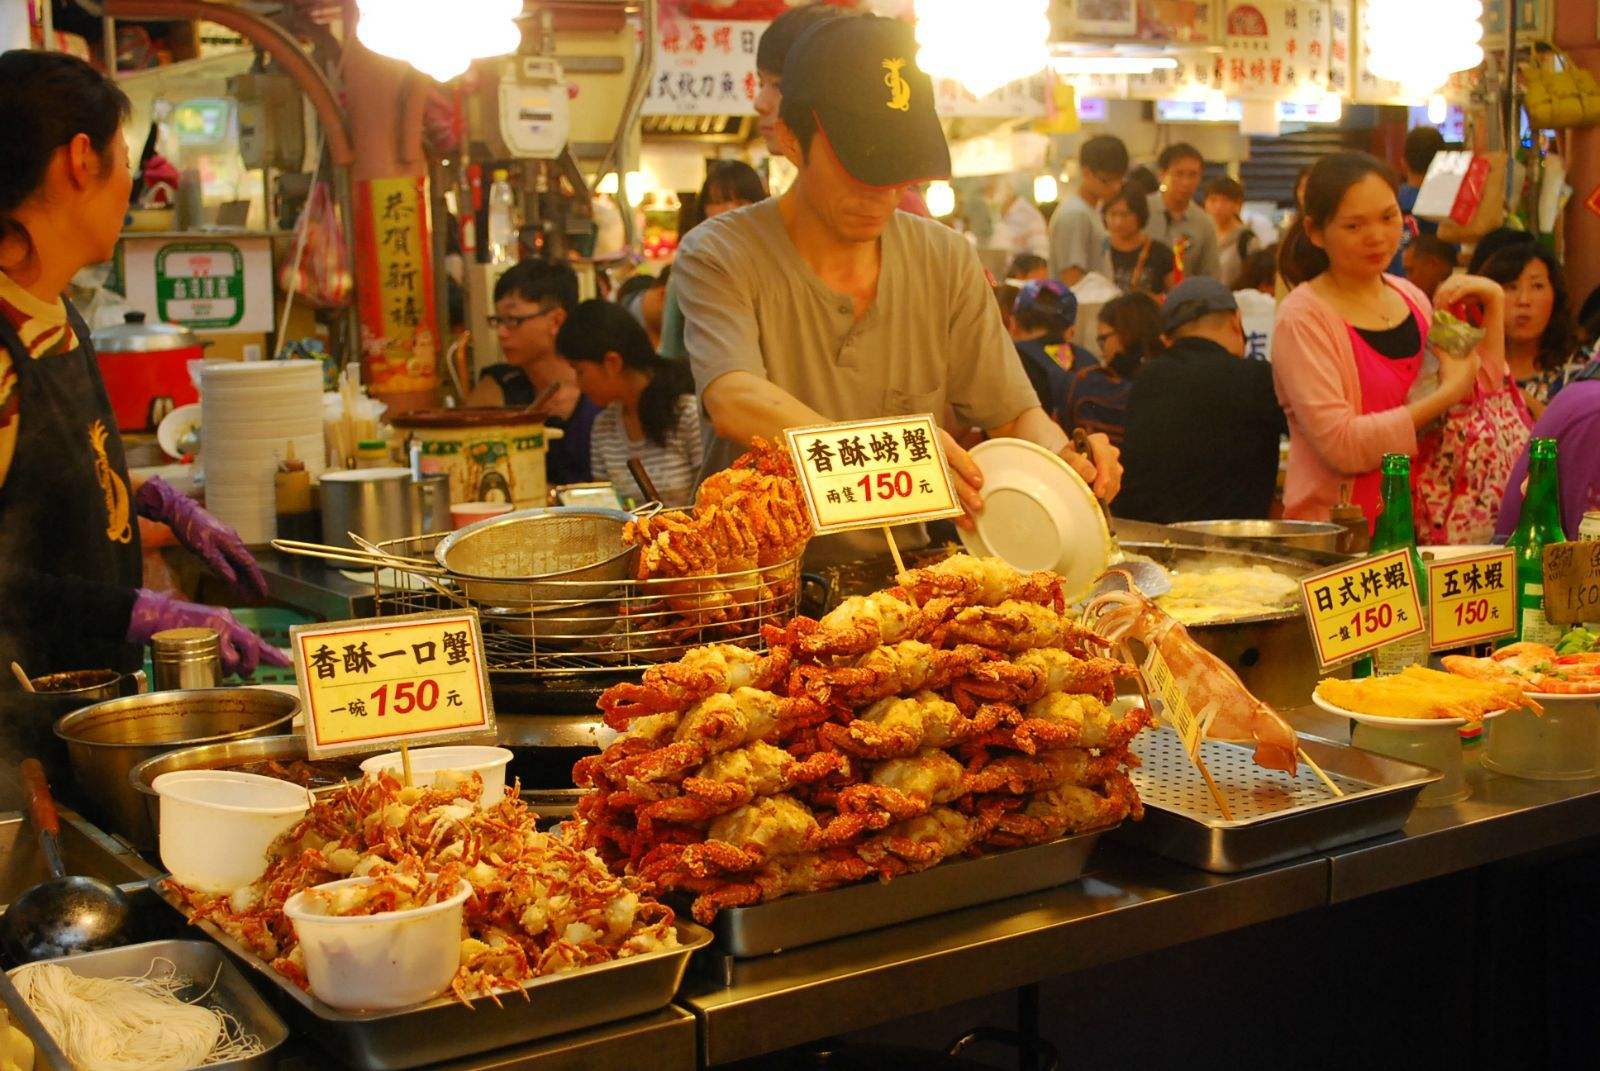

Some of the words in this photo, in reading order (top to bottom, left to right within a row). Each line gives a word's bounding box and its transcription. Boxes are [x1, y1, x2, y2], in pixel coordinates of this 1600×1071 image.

[383, 192, 420, 326] 恭賀新禧
[807, 428, 932, 473] 香酥螃蟹
[1314, 562, 1410, 612] 日式炸蝦
[1441, 561, 1505, 598] 五味蝦
[1562, 584, 1599, 612] 150
[309, 631, 472, 680] 香酥一口蟹
